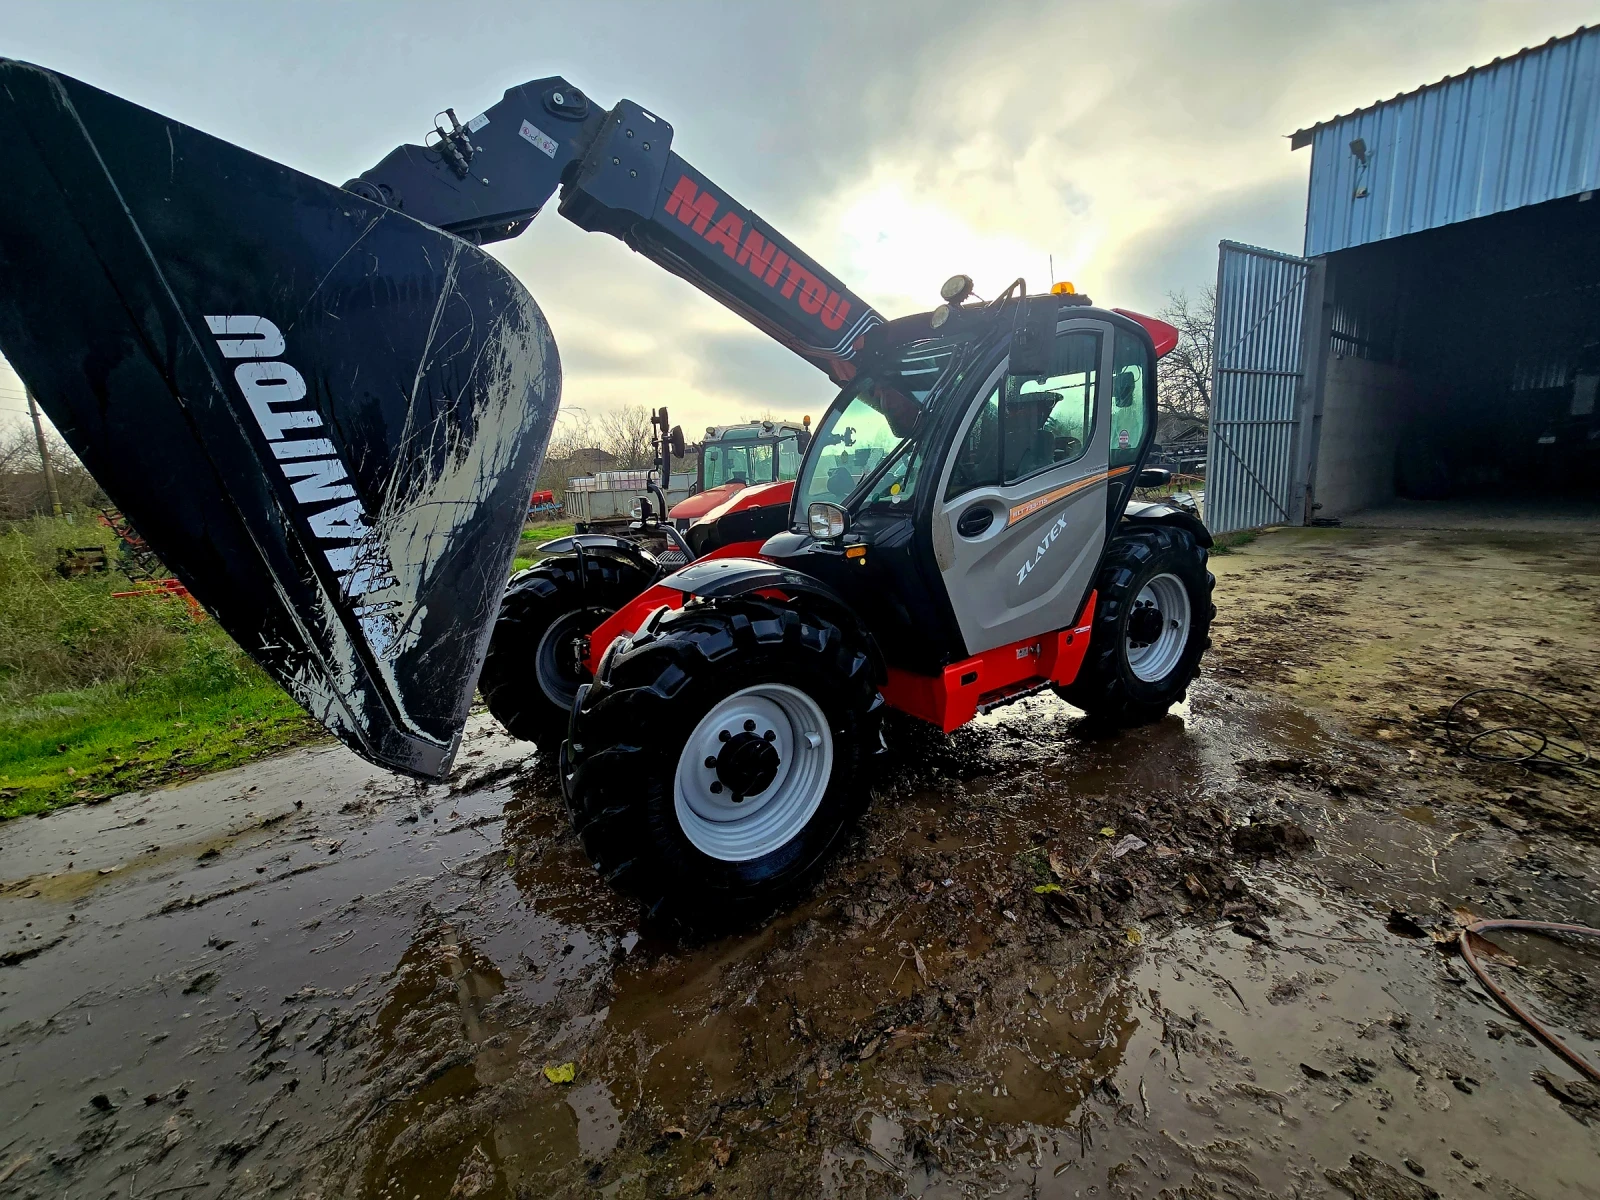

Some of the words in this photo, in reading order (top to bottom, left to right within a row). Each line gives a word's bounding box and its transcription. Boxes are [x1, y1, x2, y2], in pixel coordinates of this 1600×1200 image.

[664, 174, 850, 331] MANITOU
[203, 314, 401, 598] MANITOU
[1016, 512, 1068, 586] ZLATEX
